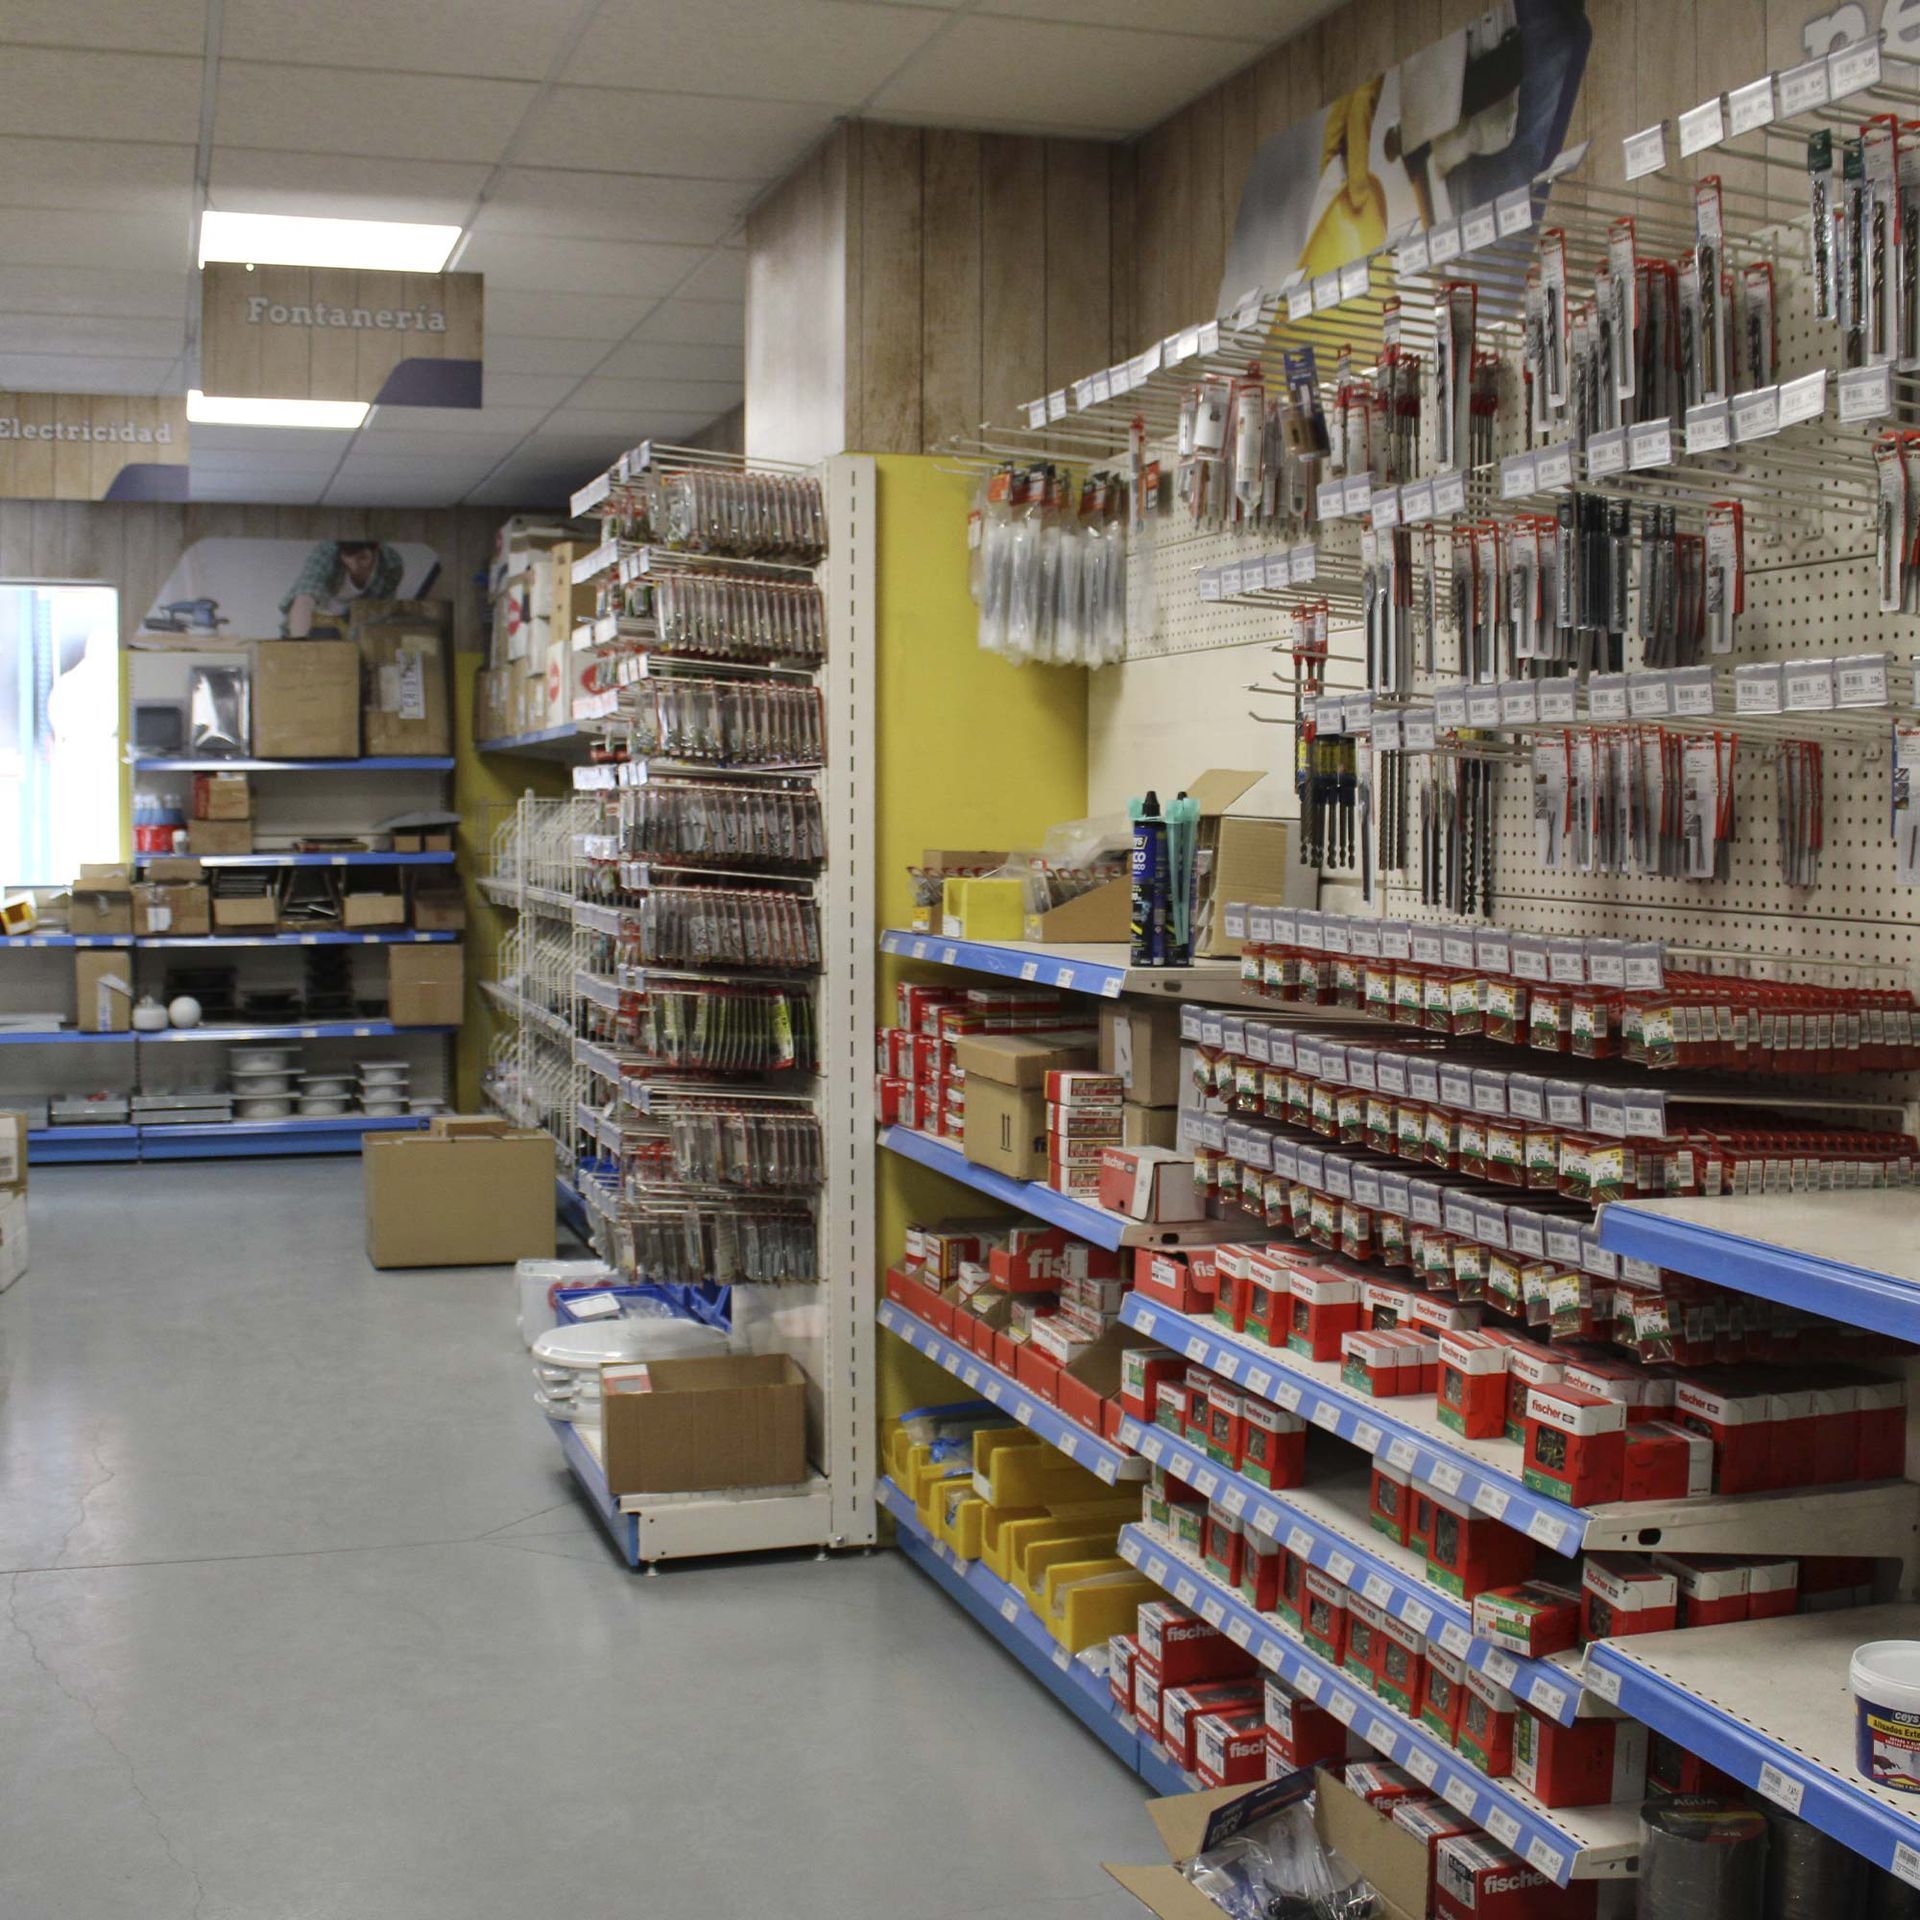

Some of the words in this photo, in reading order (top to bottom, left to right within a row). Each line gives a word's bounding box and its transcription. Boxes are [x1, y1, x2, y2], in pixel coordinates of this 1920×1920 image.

[0, 418, 171, 442] Electricidad
[1103, 1152, 1125, 1169] fischer
[1368, 1288, 1393, 1304] fischer
[1416, 1303, 1439, 1319] fischer
[1441, 1343, 1461, 1362] fischer
[1512, 1356, 1530, 1373] fischer
[1565, 1372, 1589, 1391] fischer
[1679, 1390, 1707, 1410] fischer
[1532, 1400, 1562, 1420] fischer
[1586, 1567, 1609, 1590] fischer
